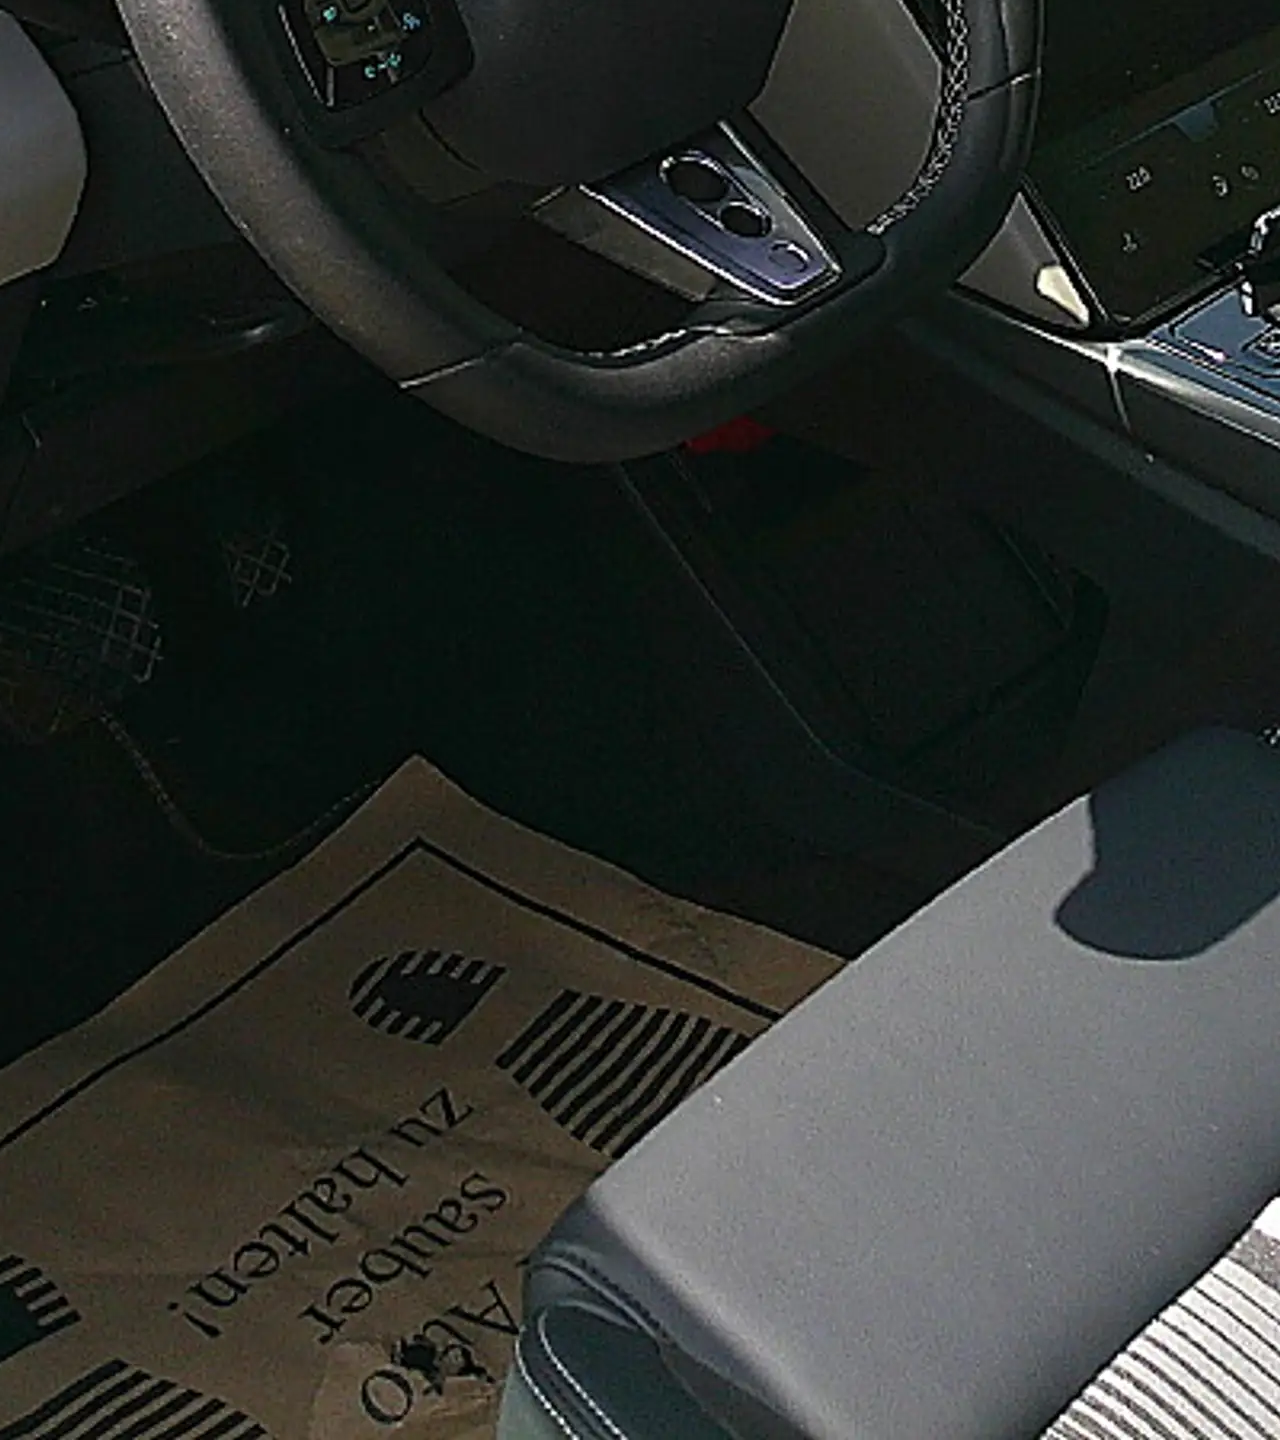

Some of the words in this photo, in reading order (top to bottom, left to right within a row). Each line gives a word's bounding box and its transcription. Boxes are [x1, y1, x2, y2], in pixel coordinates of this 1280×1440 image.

[389, 1086, 475, 1150] zu
[166, 1146, 411, 1339] halten!
[300, 1171, 510, 1346] sauber
